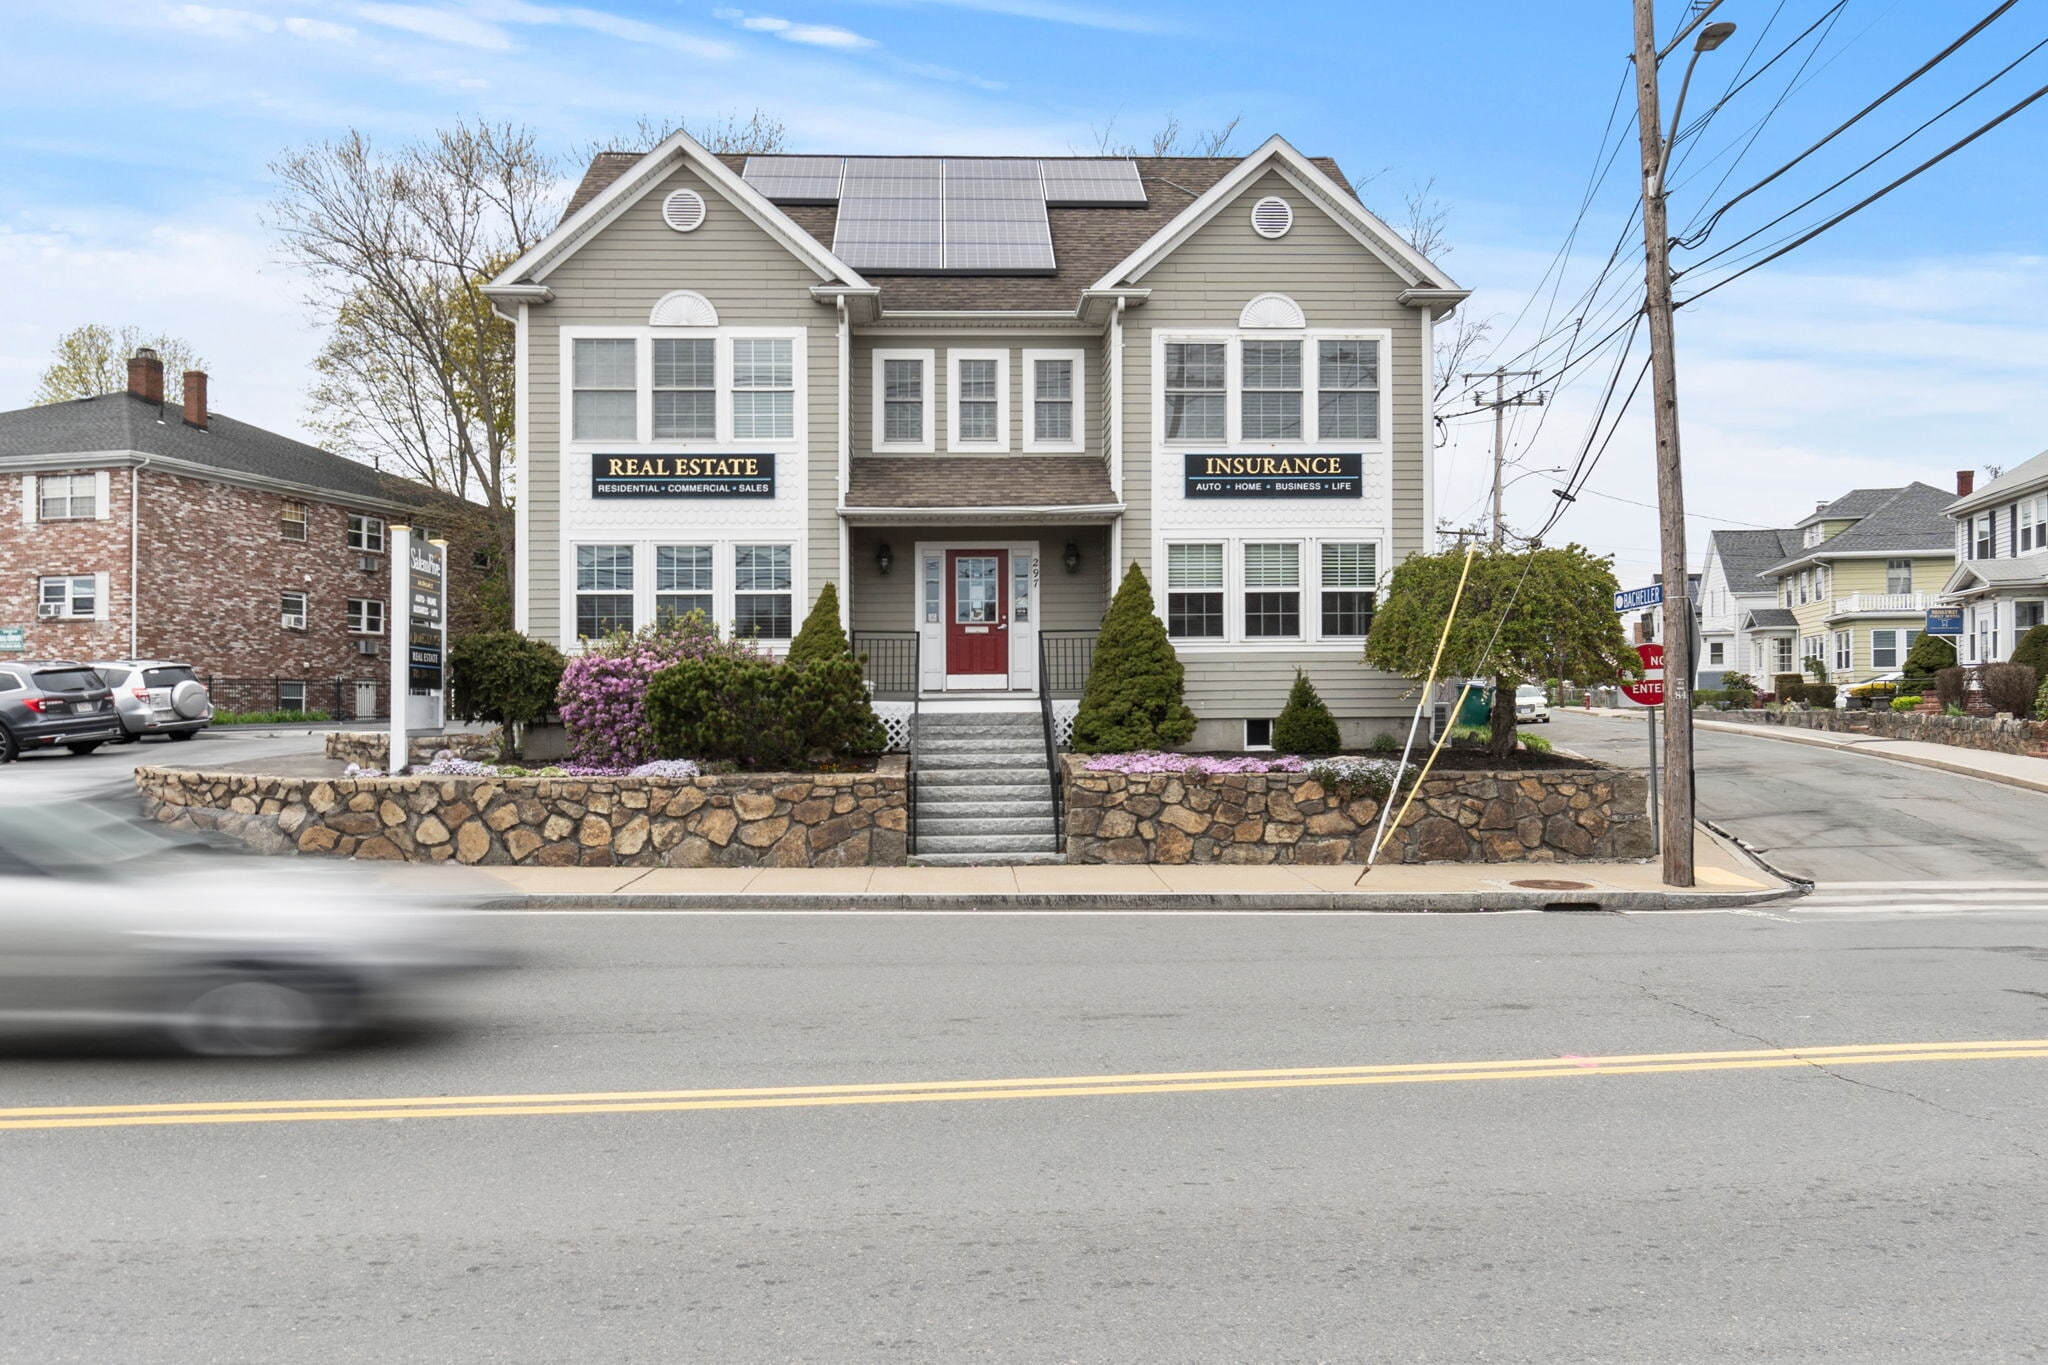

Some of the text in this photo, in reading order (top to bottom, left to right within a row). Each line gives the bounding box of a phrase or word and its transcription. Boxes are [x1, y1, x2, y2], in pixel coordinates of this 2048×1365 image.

[609, 458, 759, 476] REAL ESTATE
[1205, 457, 1342, 475] INSURANCE
[598, 484, 769, 493] RESIDENTIAL COMMERCIAL SALES
[1195, 482, 1352, 491] AUTO HOME BUSINESS LIFE
[1623, 586, 1660, 609] BACHELLER
[412, 651, 438, 663] REAL ESTATE
[1650, 655, 1664, 666] NO
[1675, 690, 1688, 700] 84
